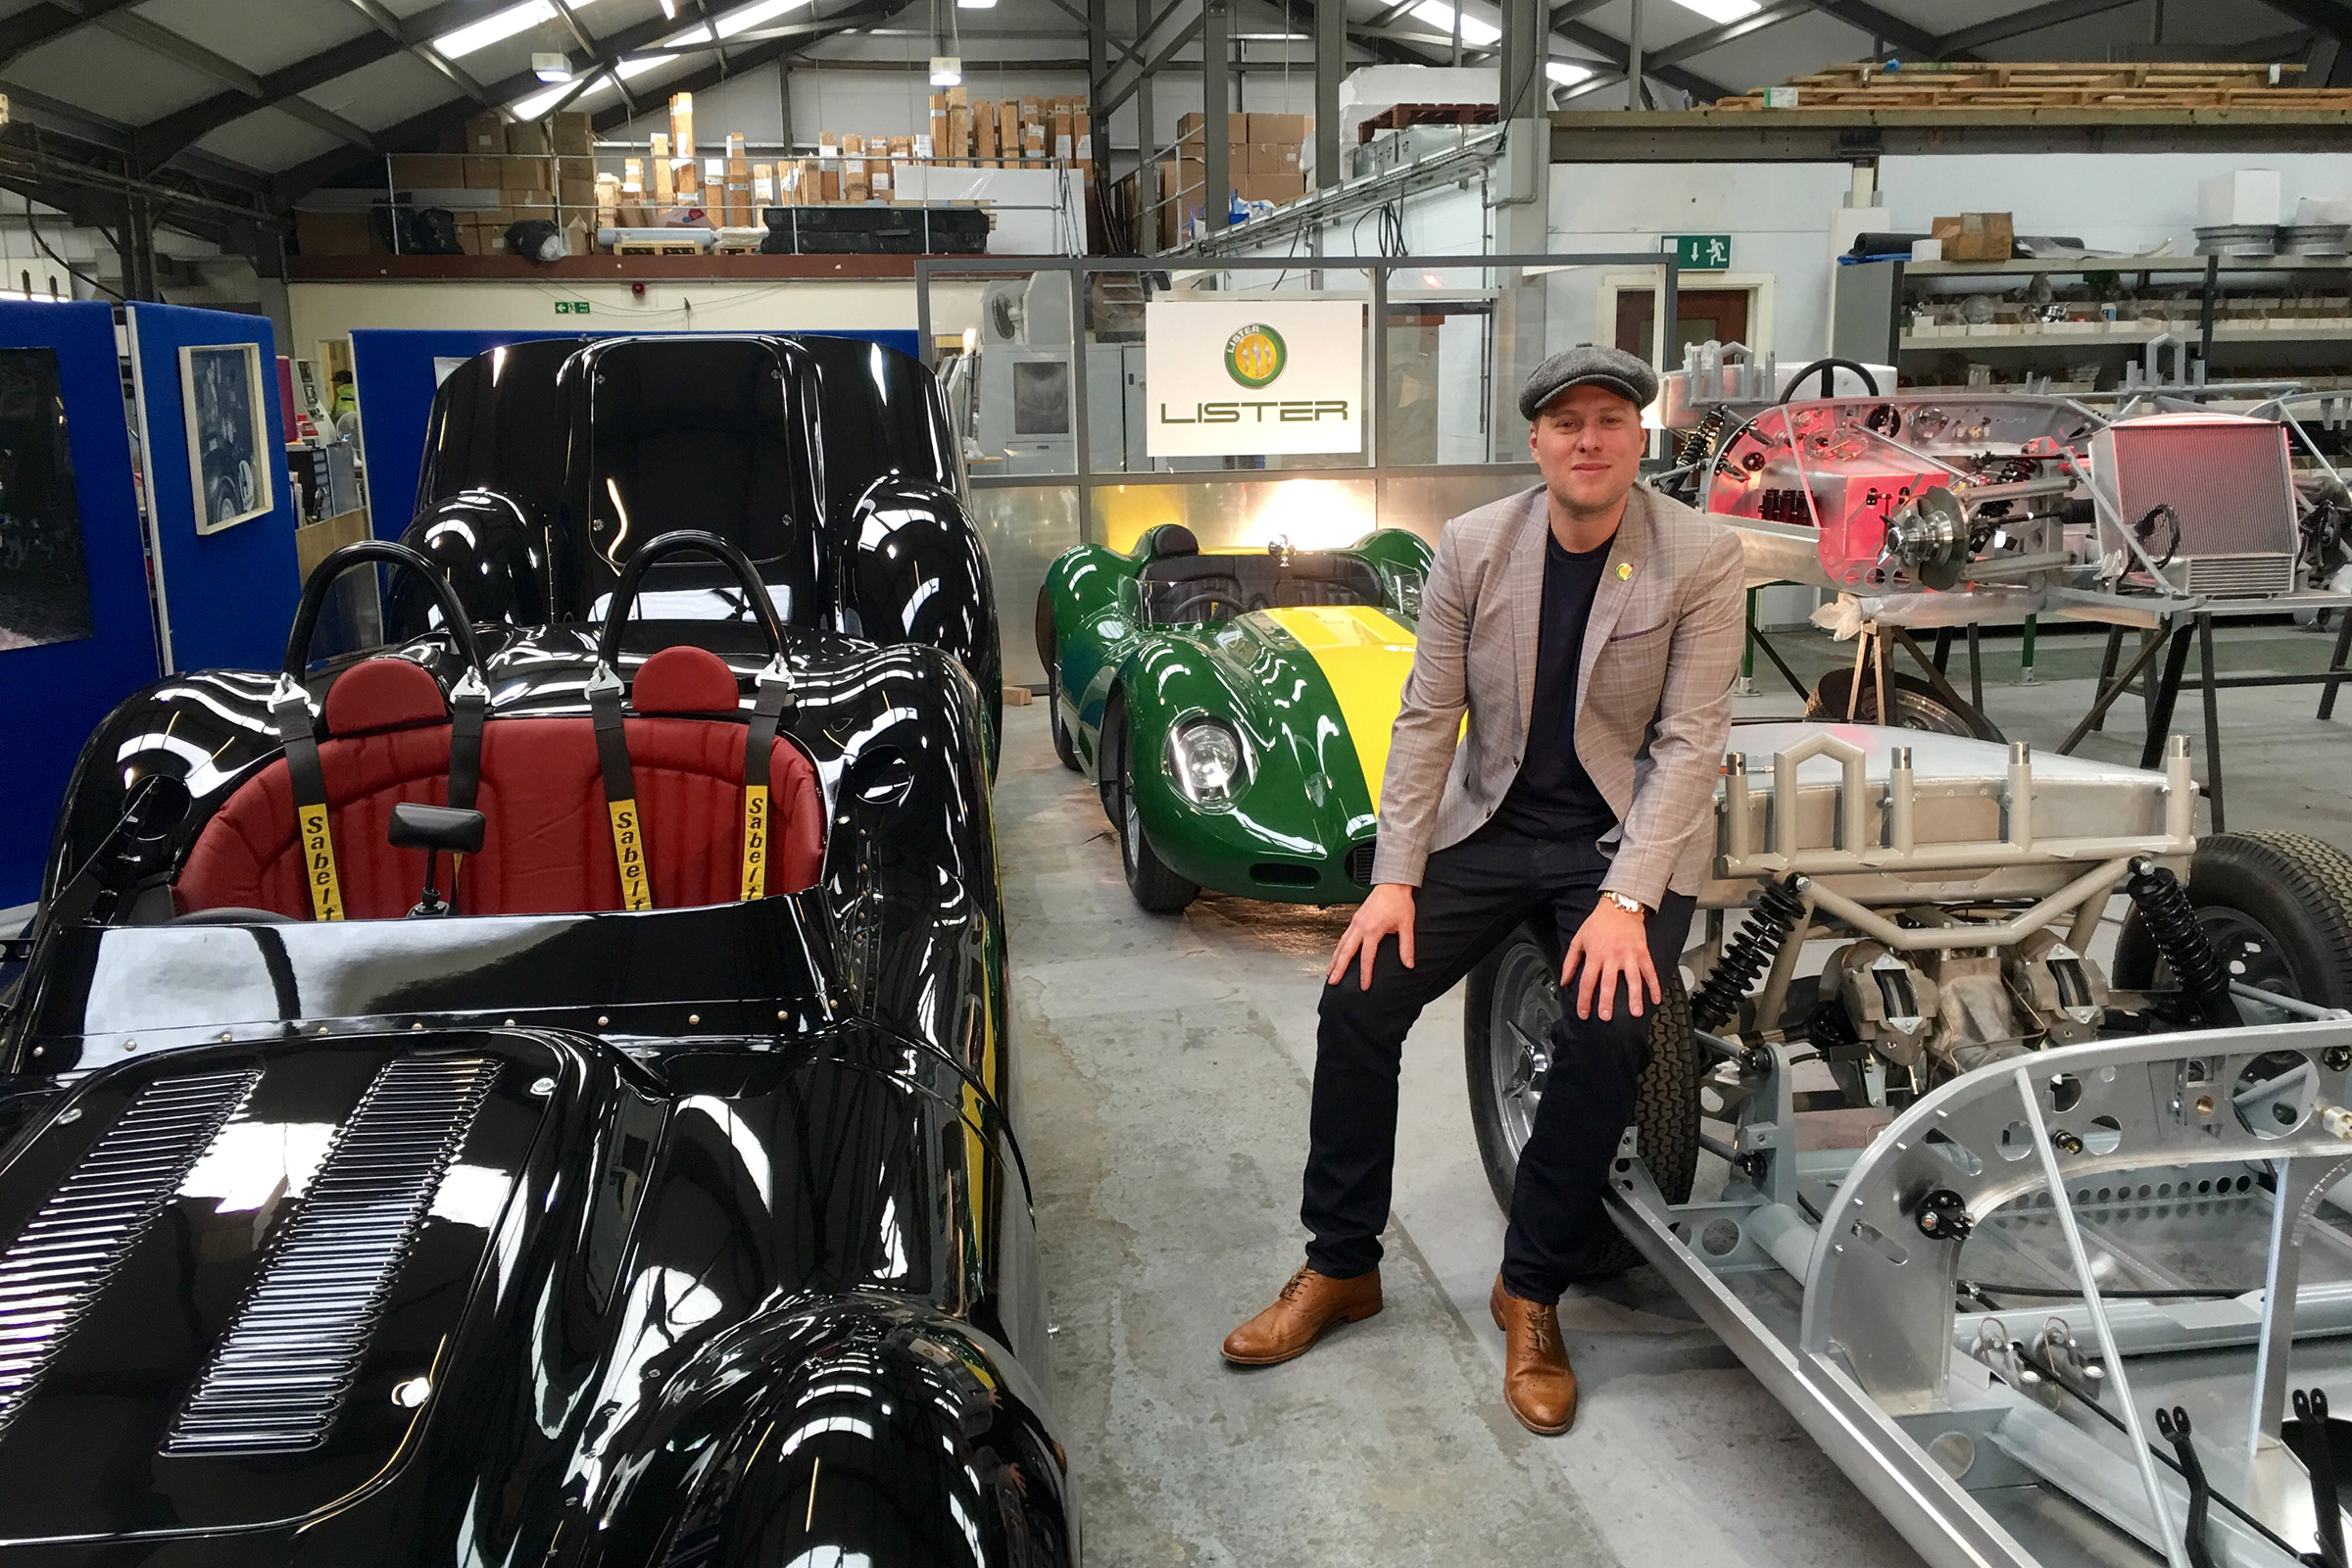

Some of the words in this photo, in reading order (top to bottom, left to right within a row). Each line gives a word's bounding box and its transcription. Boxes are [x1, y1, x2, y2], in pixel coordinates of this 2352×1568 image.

[1227, 325, 1259, 353] LISTER
[1161, 401, 1348, 423] LISTER
[306, 815, 335, 921] Sabelt
[616, 811, 643, 910] Sabelt
[748, 798, 764, 901] Sabelt
